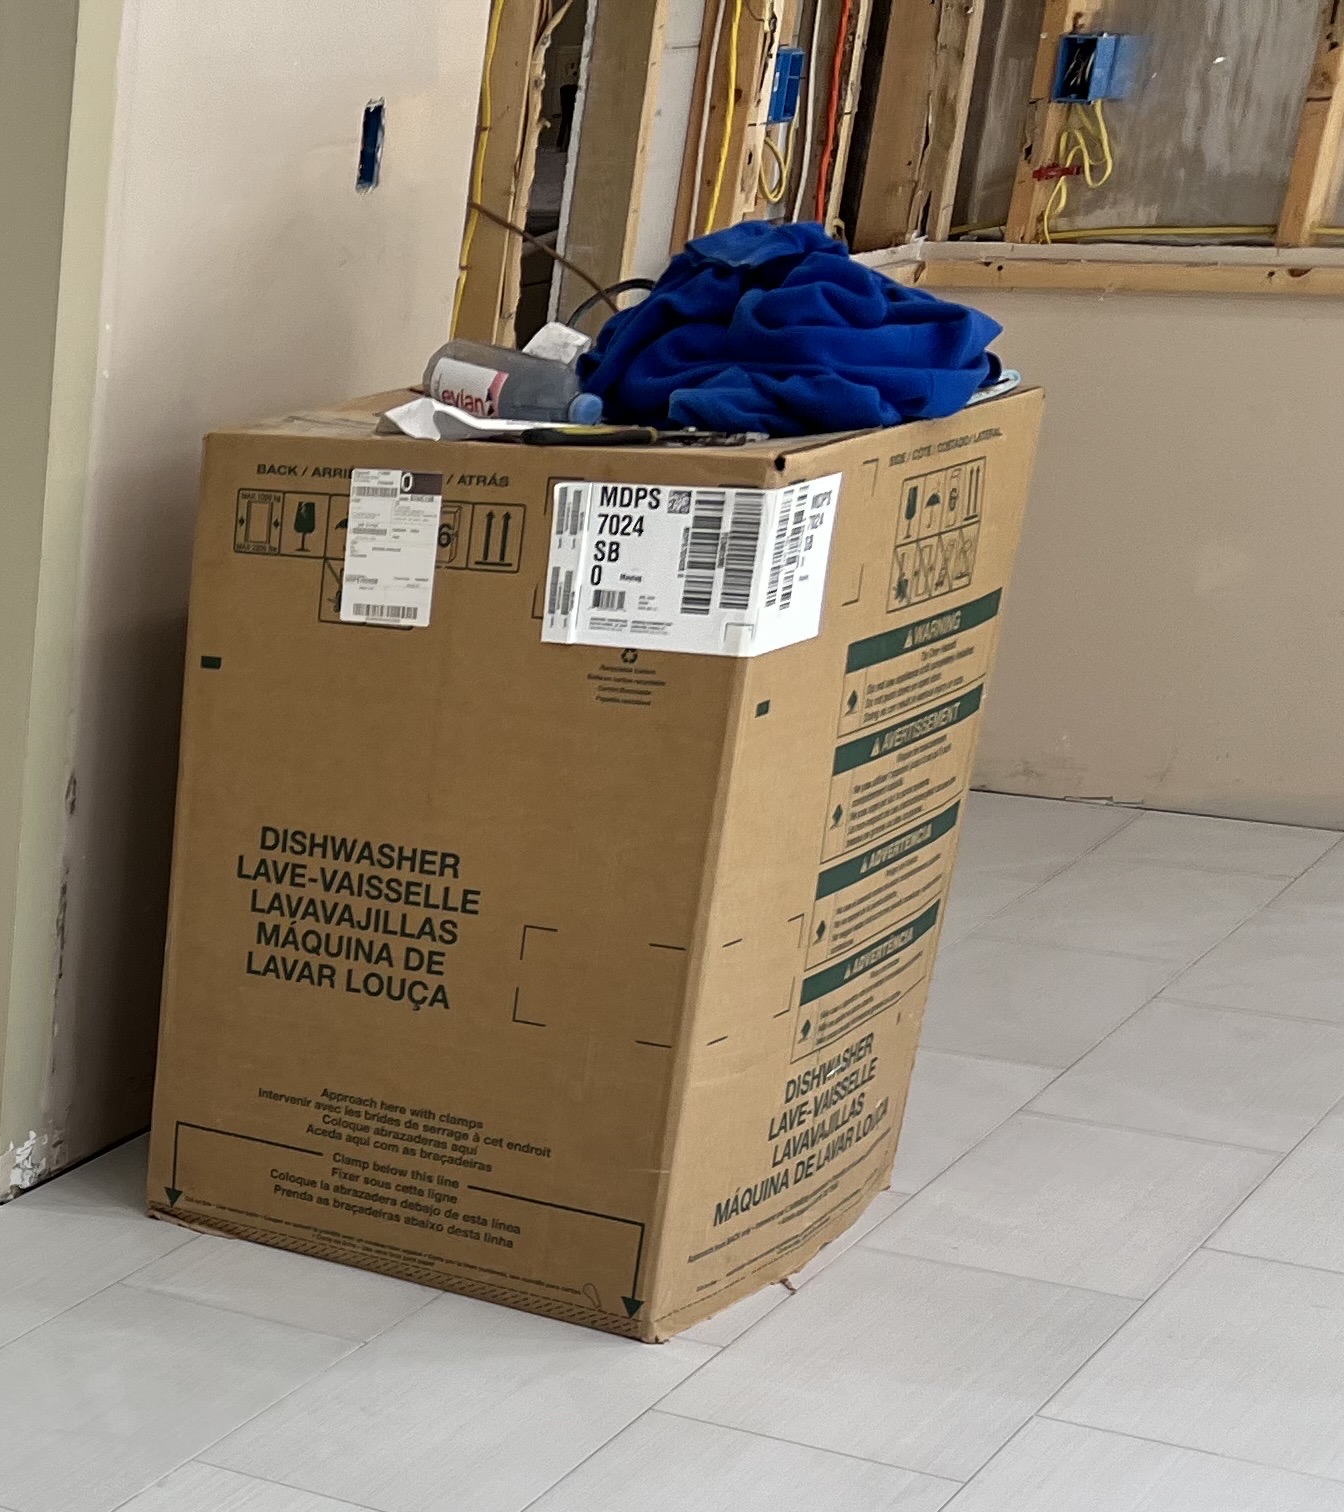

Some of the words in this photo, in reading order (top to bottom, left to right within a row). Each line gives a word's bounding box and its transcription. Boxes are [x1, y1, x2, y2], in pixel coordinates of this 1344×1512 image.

[256, 463, 298, 477] BACK
[457, 472, 509, 488] ATRÁS
[600, 485, 661, 510] MDPS
[593, 540, 620, 563] SB
[597, 513, 644, 538] 7024
[590, 565, 602, 586] 0
[259, 825, 460, 879] DISHWASHER
[236, 854, 481, 915] LAVE-VAISSELLE
[250, 888, 459, 945] LAVAVAJILLAS
[256, 920, 394, 968] MÁQUINA
[403, 946, 446, 976] DE
[246, 951, 337, 989] LAVAR
[345, 968, 450, 1011] LOUÇA
[784, 1032, 874, 1104] DISHWASHER
[258, 1087, 312, 1107] Intervenir
[314, 1100, 342, 1115] avec
[344, 1105, 362, 1119] les
[364, 1110, 402, 1127] brides
[404, 1119, 419, 1131] de
[422, 1123, 469, 1141] serrage
[483, 1136, 504, 1149] cet
[506, 1140, 552, 1158] endroit
[320, 1088, 377, 1109] Approach
[380, 1100, 406, 1115] here
[410, 1108, 436, 1121] with
[439, 1113, 484, 1131] clamps
[768, 1057, 878, 1141] LAVE-VAISSELLE
[306, 1124, 343, 1140] Aceda
[373, 1140, 399, 1153] com
[402, 1145, 417, 1157] as
[419, 1148, 492, 1172] braçadeiras
[322, 1114, 370, 1133] Coloque
[373, 1125, 448, 1150] abrazaderas
[270, 1168, 317, 1188] Coloque
[320, 1179, 331, 1191] la
[332, 1184, 398, 1207] abrazadera
[400, 1199, 442, 1217] debajo
[444, 1209, 460, 1221] de
[462, 1213, 488, 1227] esta
[330, 1167, 360, 1182] Fixer
[363, 1176, 392, 1190] sous
[394, 1183, 425, 1197] cette
[427, 1188, 459, 1204] ligne
[332, 1152, 370, 1171] Clamp
[372, 1161, 409, 1178] below
[410, 1169, 434, 1184] this
[436, 1174, 460, 1189] line
[713, 1168, 789, 1227] MÁQUINA
[793, 1156, 815, 1186] DE
[273, 1184, 313, 1202] Prenda
[316, 1196, 330, 1207] as
[332, 1198, 401, 1223] braçadeiras
[404, 1215, 444, 1233] abaixo
[447, 1224, 481, 1241] desta
[483, 1232, 514, 1249] linha
